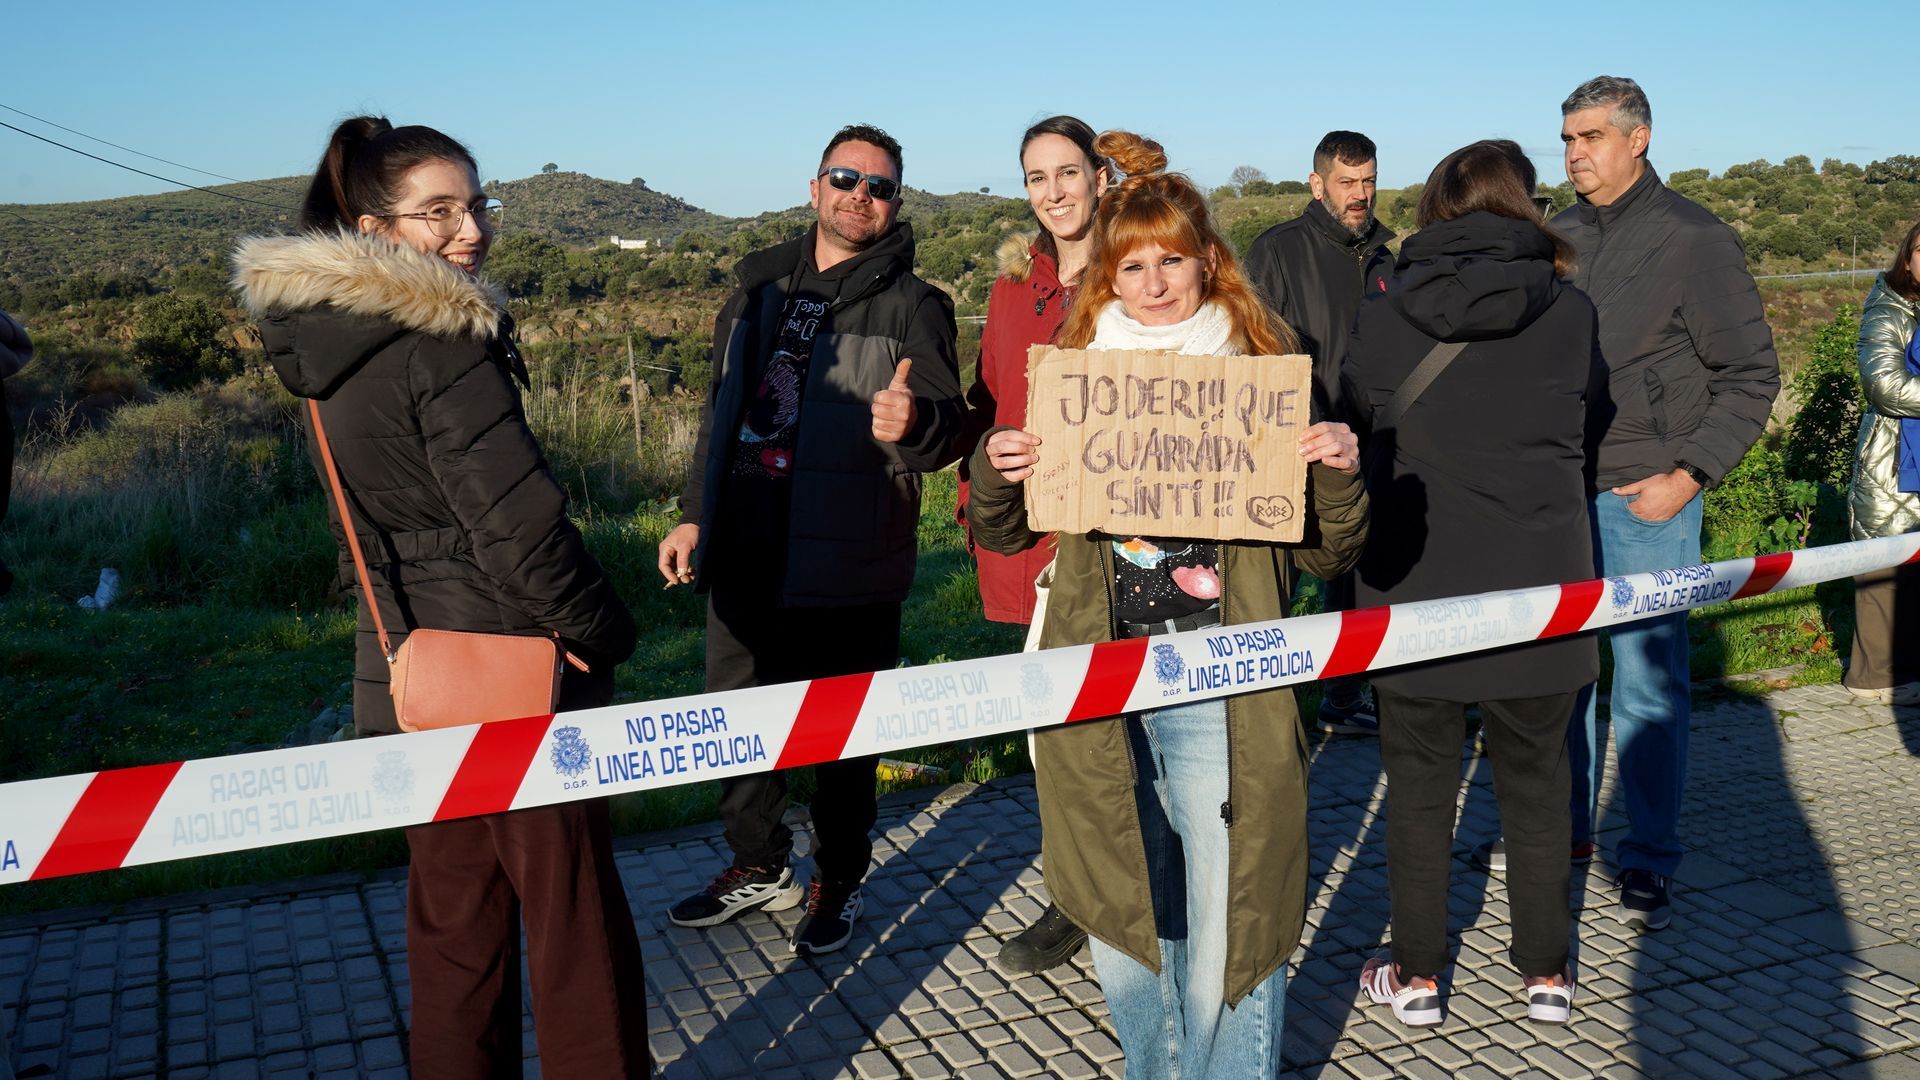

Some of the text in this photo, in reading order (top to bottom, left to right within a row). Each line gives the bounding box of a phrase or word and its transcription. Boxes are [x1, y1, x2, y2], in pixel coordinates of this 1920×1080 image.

[1235, 383, 1299, 436] QUE
[1082, 427, 1257, 474] GUARRADA
[1256, 504, 1287, 518] ROBE
[1650, 564, 1714, 587] NO PASAR
[1633, 580, 1731, 615] LINEA DE POLICIA
[1206, 628, 1287, 658] NO PASAR
[1188, 650, 1314, 692] LINEA DE POLICIA
[626, 706, 727, 745] NO PASAR
[596, 734, 766, 785] LINEA DE POLICIA
[564, 780, 589, 790] D.G.P.
